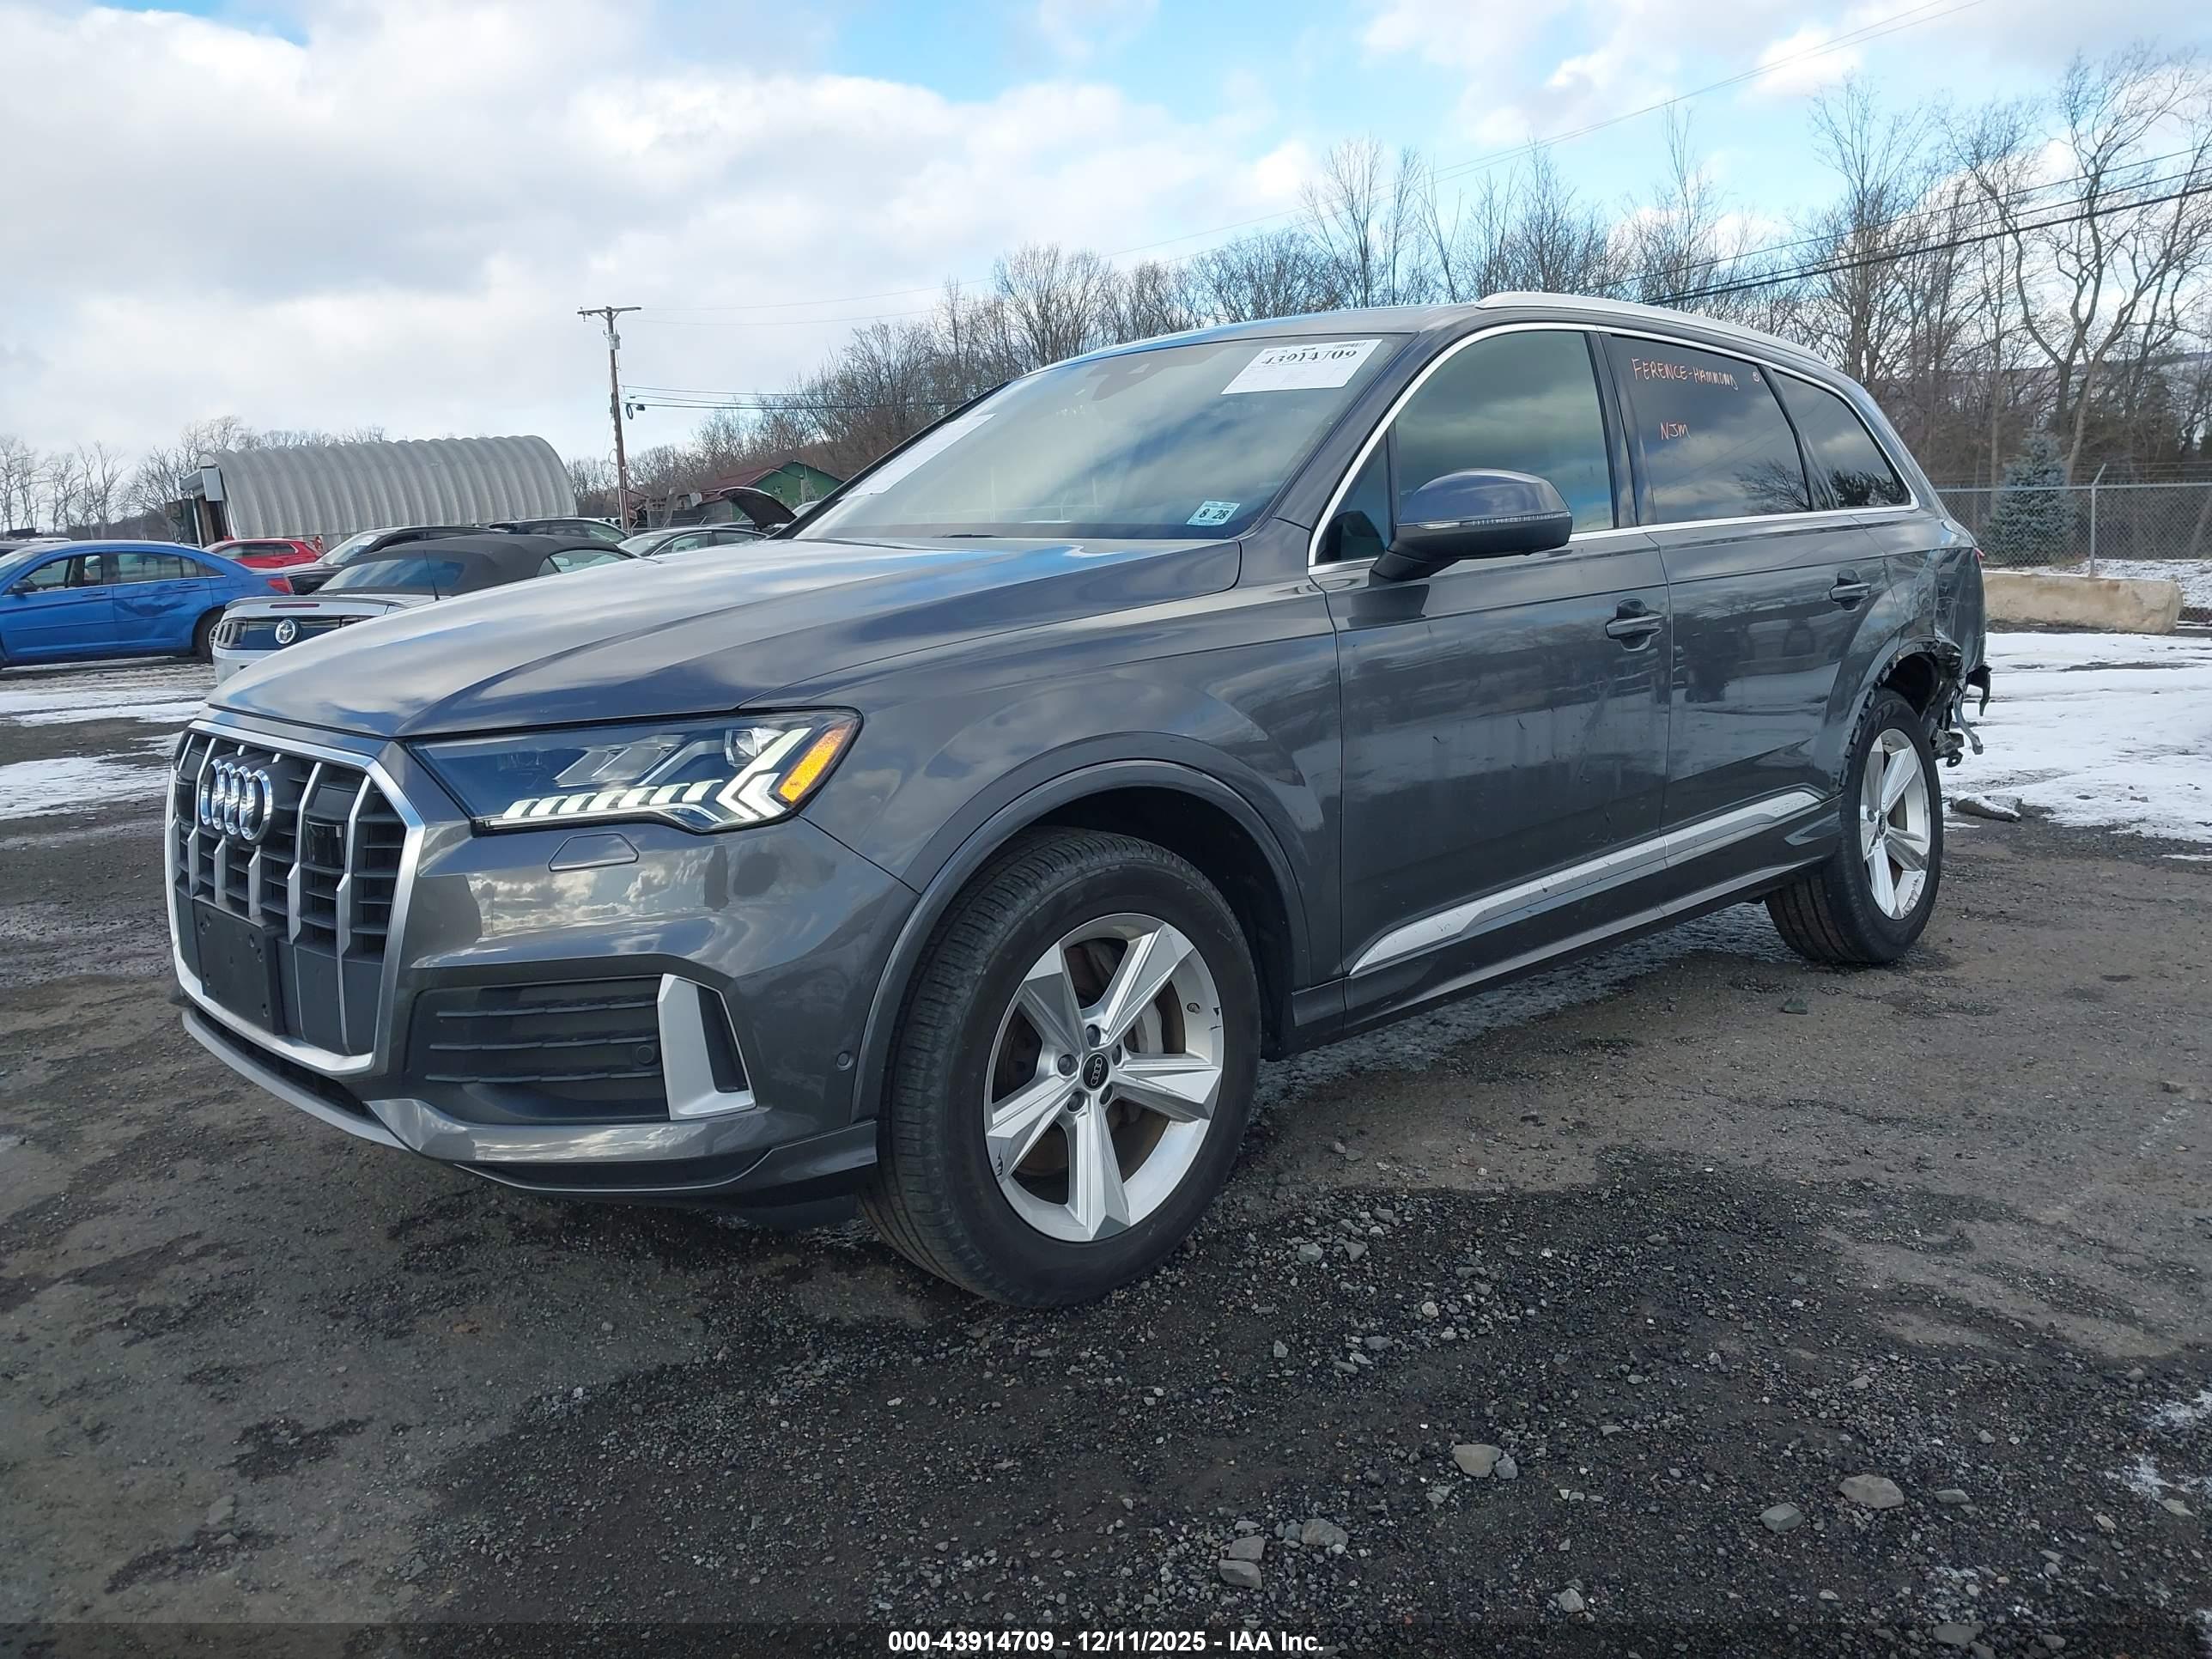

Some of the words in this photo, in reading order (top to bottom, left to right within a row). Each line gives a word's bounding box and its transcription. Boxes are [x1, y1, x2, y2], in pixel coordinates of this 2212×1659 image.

[1261, 349, 1358, 365] 43914709
[1660, 422, 1691, 441] NJM
[1199, 508, 1210, 518] 8
[1212, 509, 1230, 520] 28
